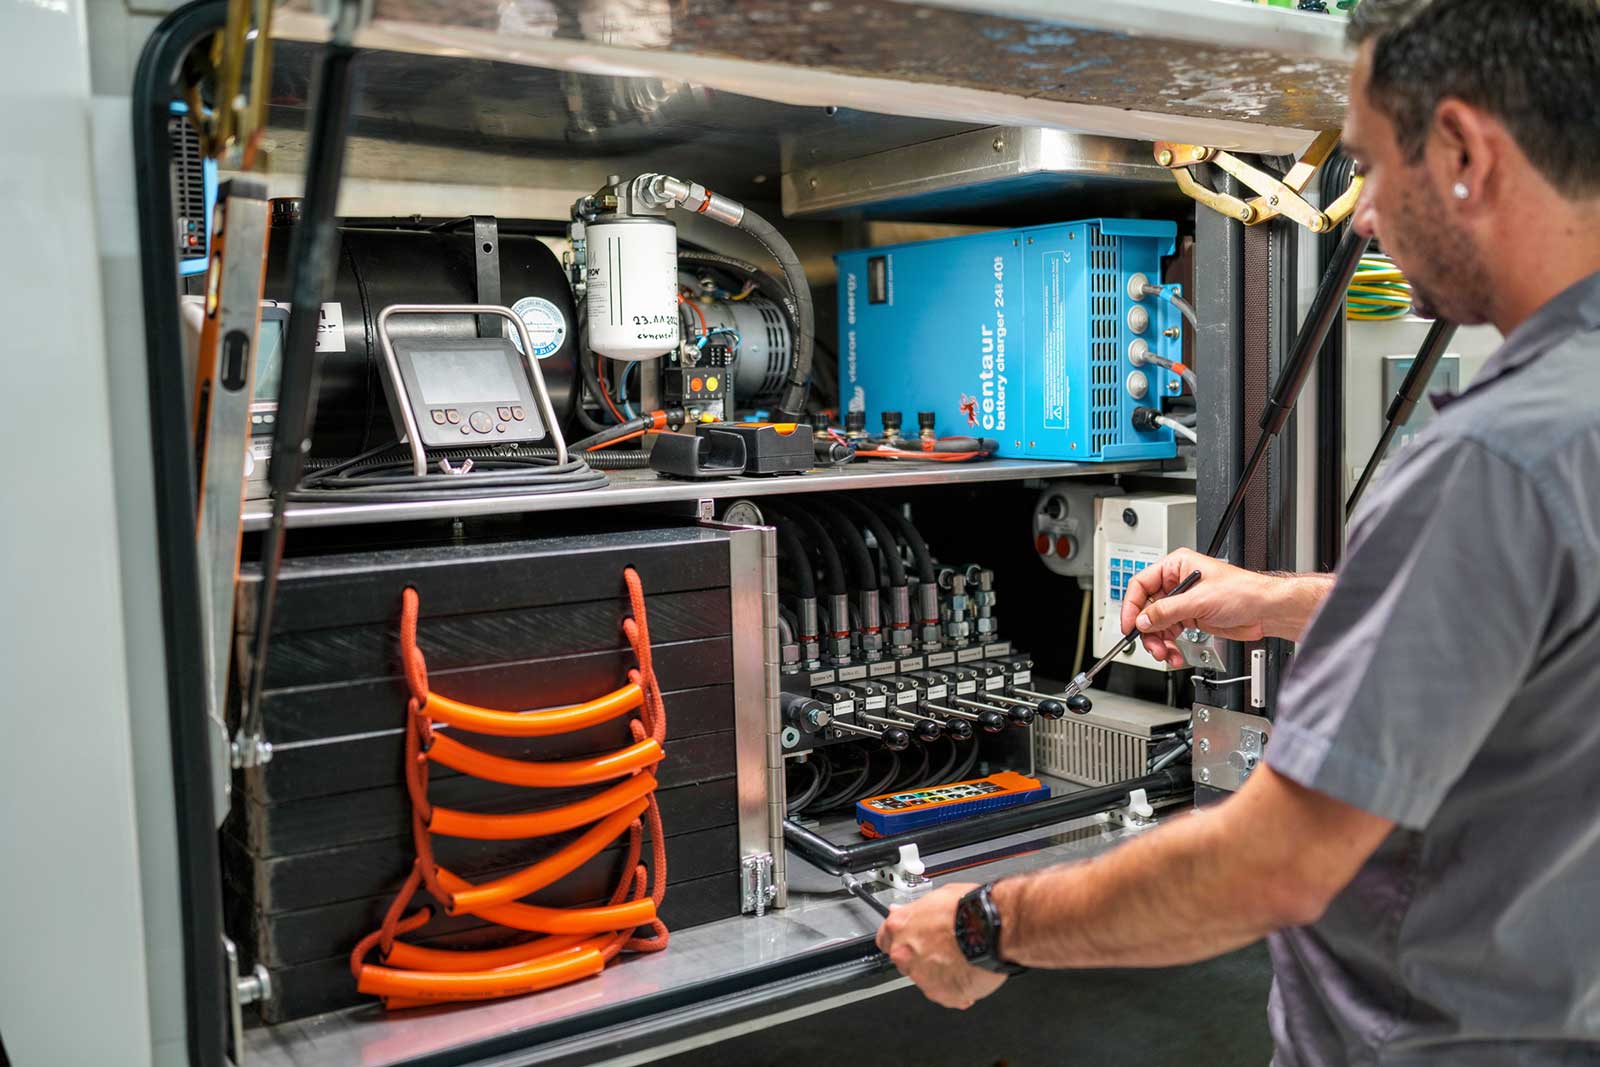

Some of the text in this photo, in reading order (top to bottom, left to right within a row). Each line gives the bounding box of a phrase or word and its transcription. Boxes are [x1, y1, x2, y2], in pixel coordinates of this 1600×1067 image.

[847, 273, 858, 383] victron energy
[995, 310, 1007, 372] charger
[979, 324, 995, 431] centaur
[995, 374, 1008, 431] battery
